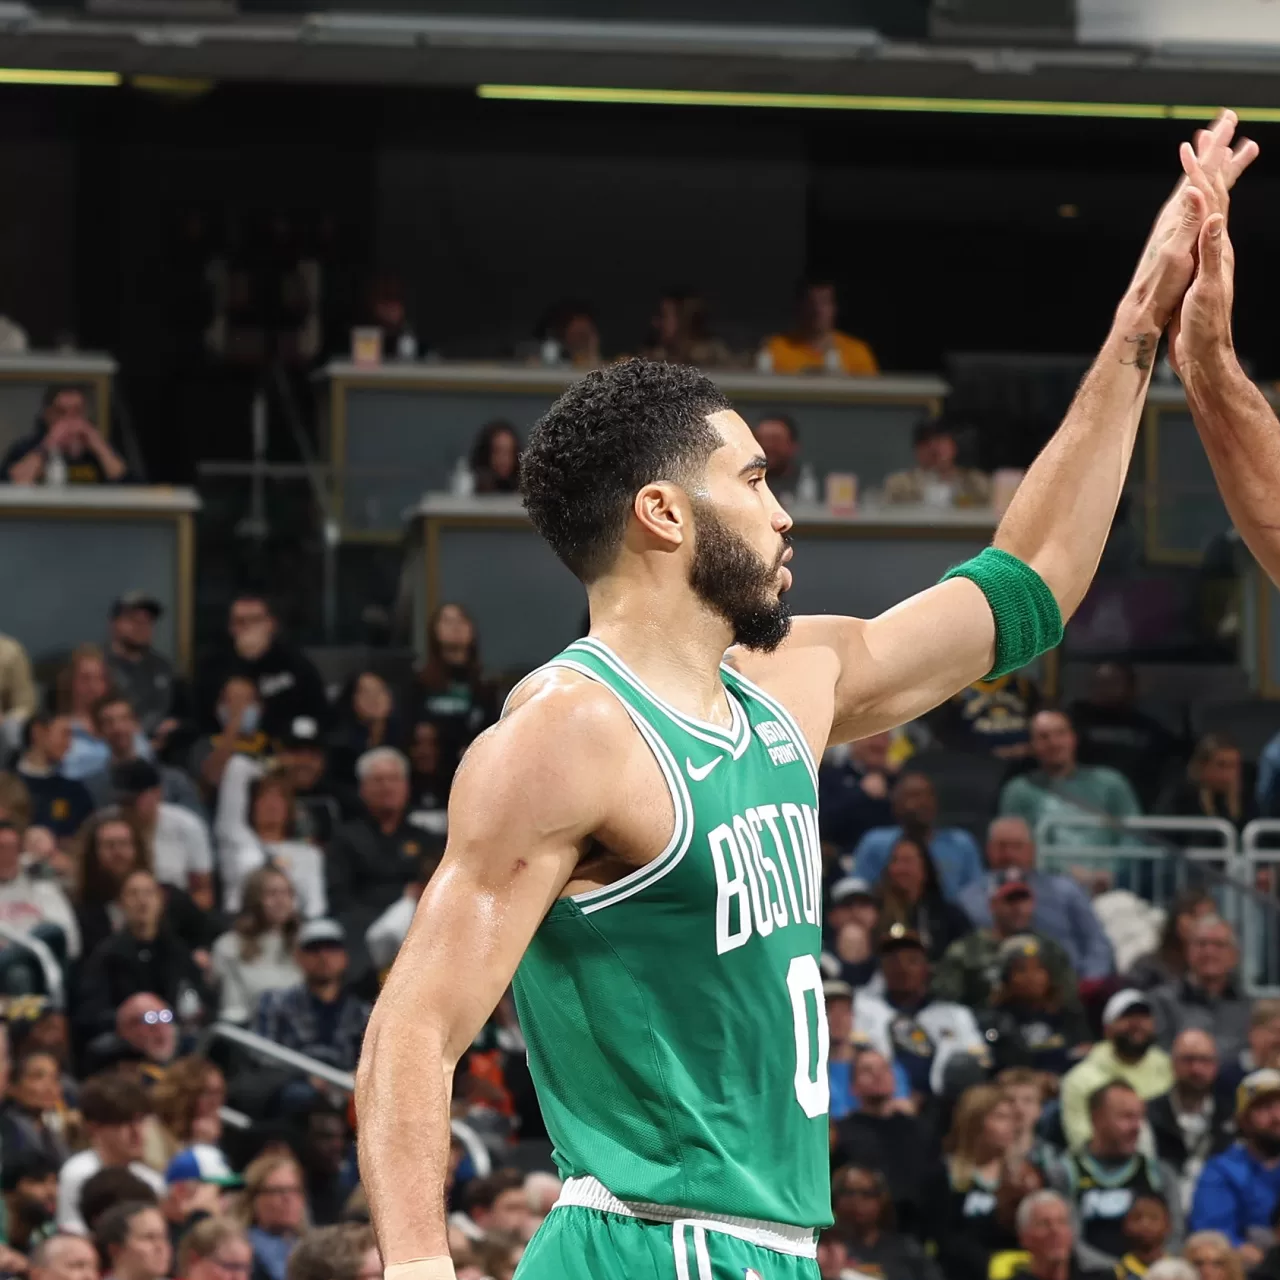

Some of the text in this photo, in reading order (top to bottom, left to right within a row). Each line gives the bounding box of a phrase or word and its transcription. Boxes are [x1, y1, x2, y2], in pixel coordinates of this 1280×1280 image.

[754, 720, 791, 747] VISTA
[767, 743, 799, 766] PRINT
[707, 802, 822, 955] BOSTON
[786, 953, 830, 1119] 0
